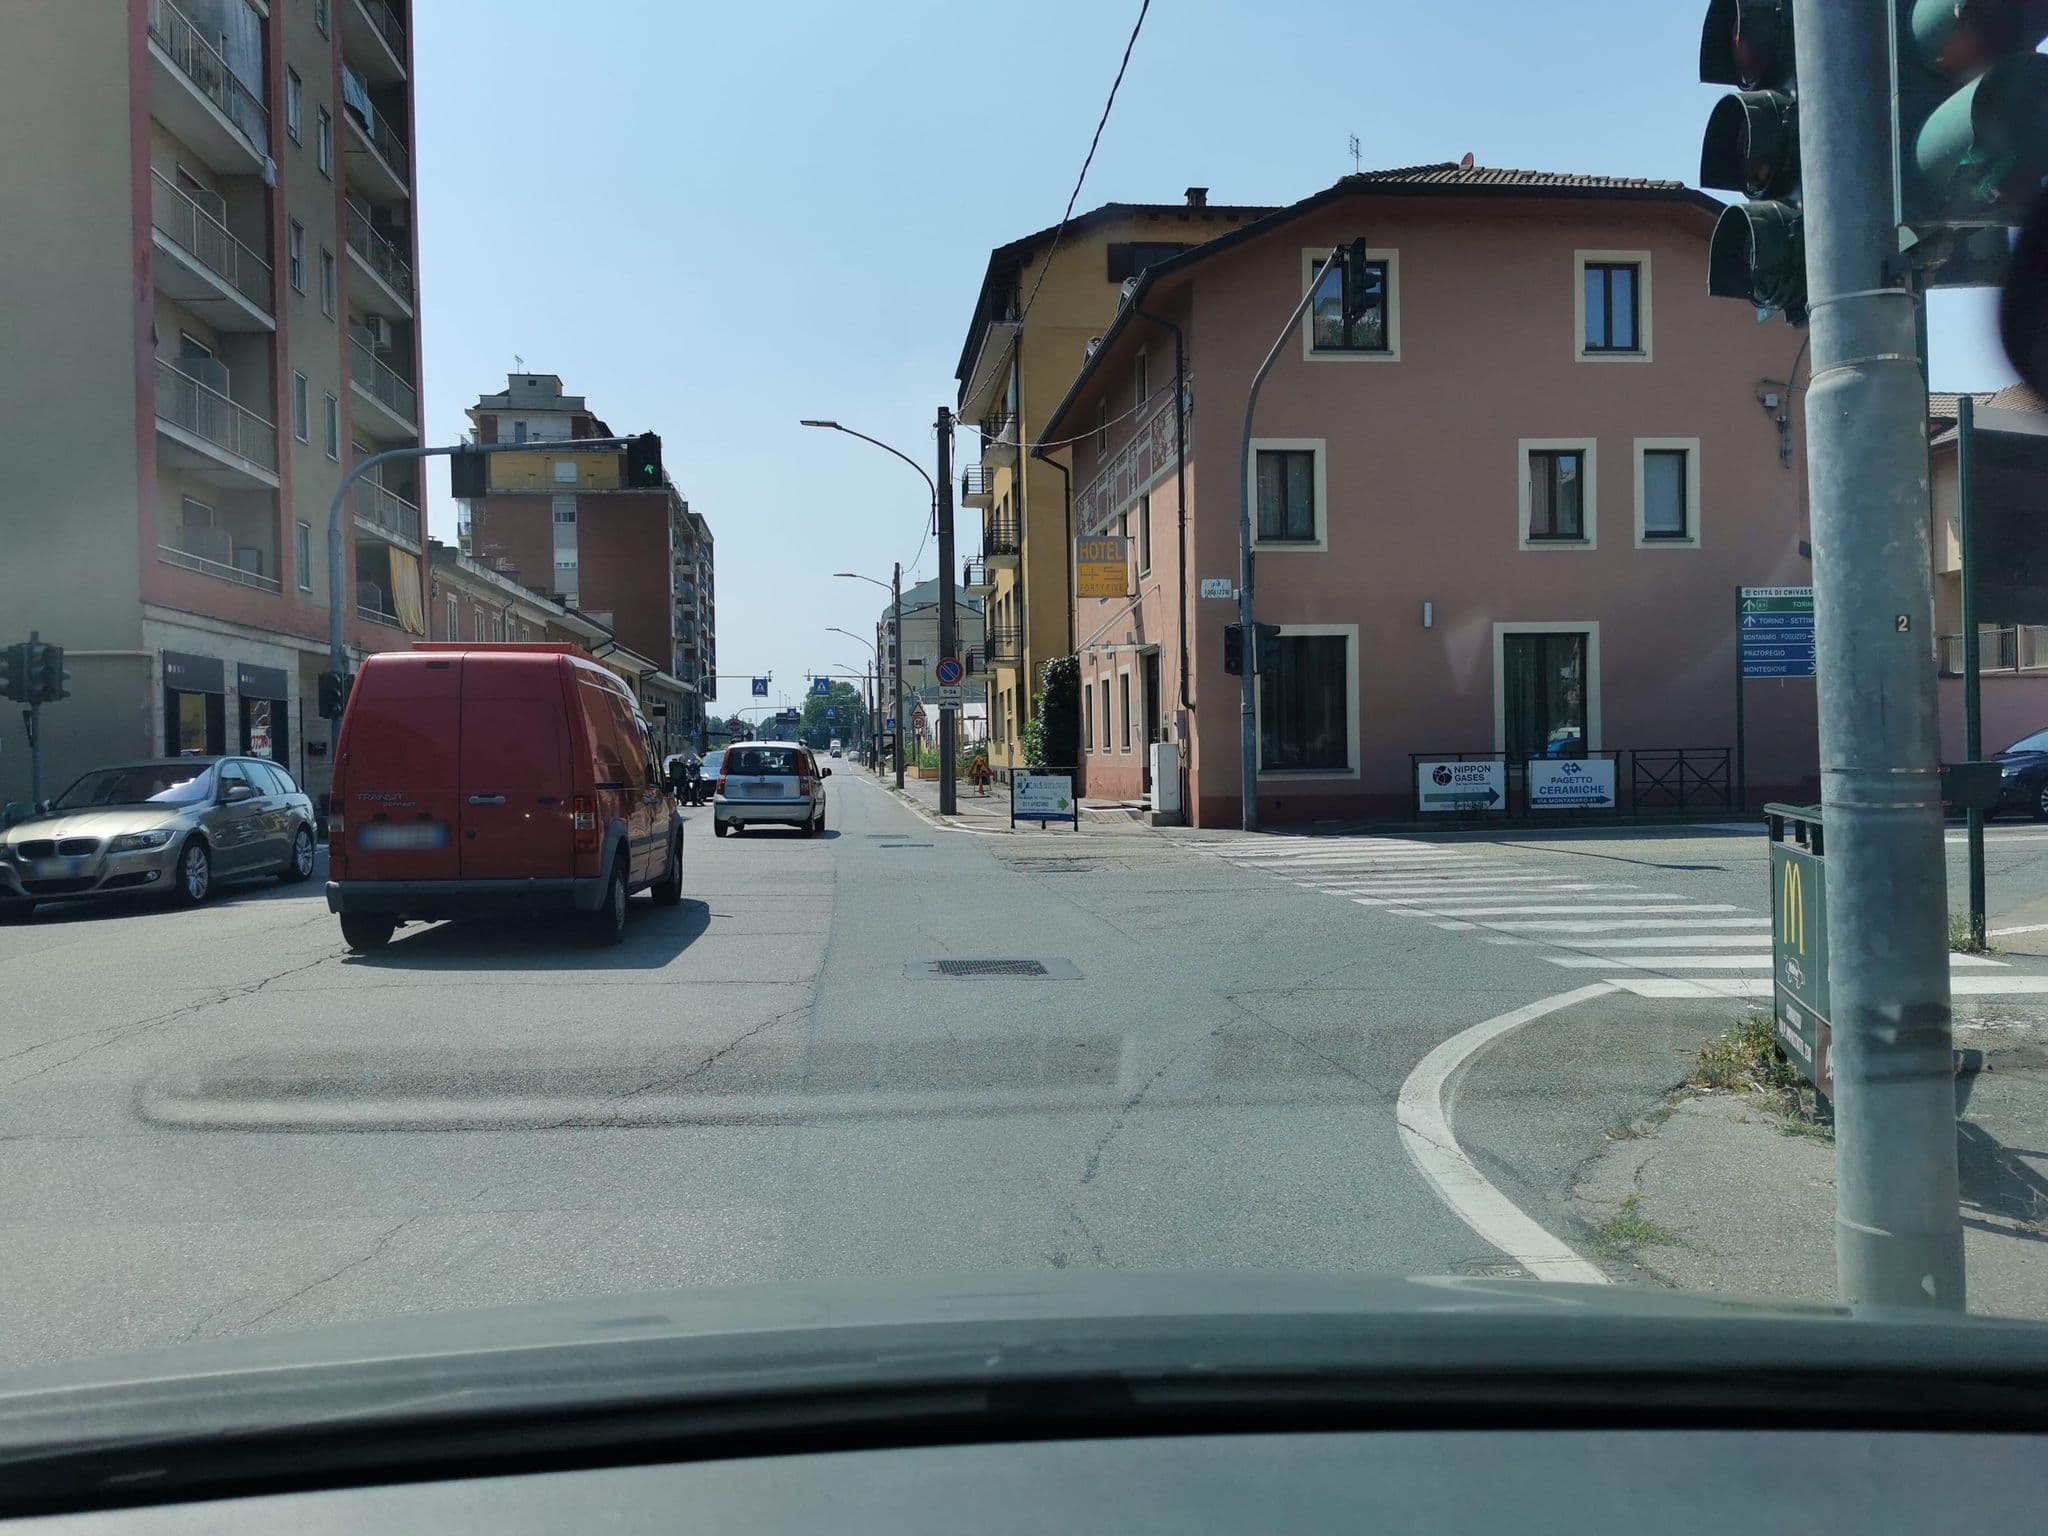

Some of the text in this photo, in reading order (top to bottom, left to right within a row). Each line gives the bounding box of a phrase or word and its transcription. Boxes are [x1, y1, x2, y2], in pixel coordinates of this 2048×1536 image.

[1080, 541, 1123, 561] HOTEL
[1759, 617, 1785, 625] TORINO
[1790, 617, 1814, 625] SETTIM
[1898, 615, 1908, 632] 2
[1744, 649, 1786, 657] PRATOREGIO
[1744, 665, 1788, 673] MONTEGIOVE
[1454, 765, 1491, 774] NIPPON
[1454, 773, 1485, 782] GASES
[1551, 776, 1593, 784] PAGETTO
[1539, 785, 1605, 795] CERAMICHE
[357, 792, 403, 801] TRANSIT
